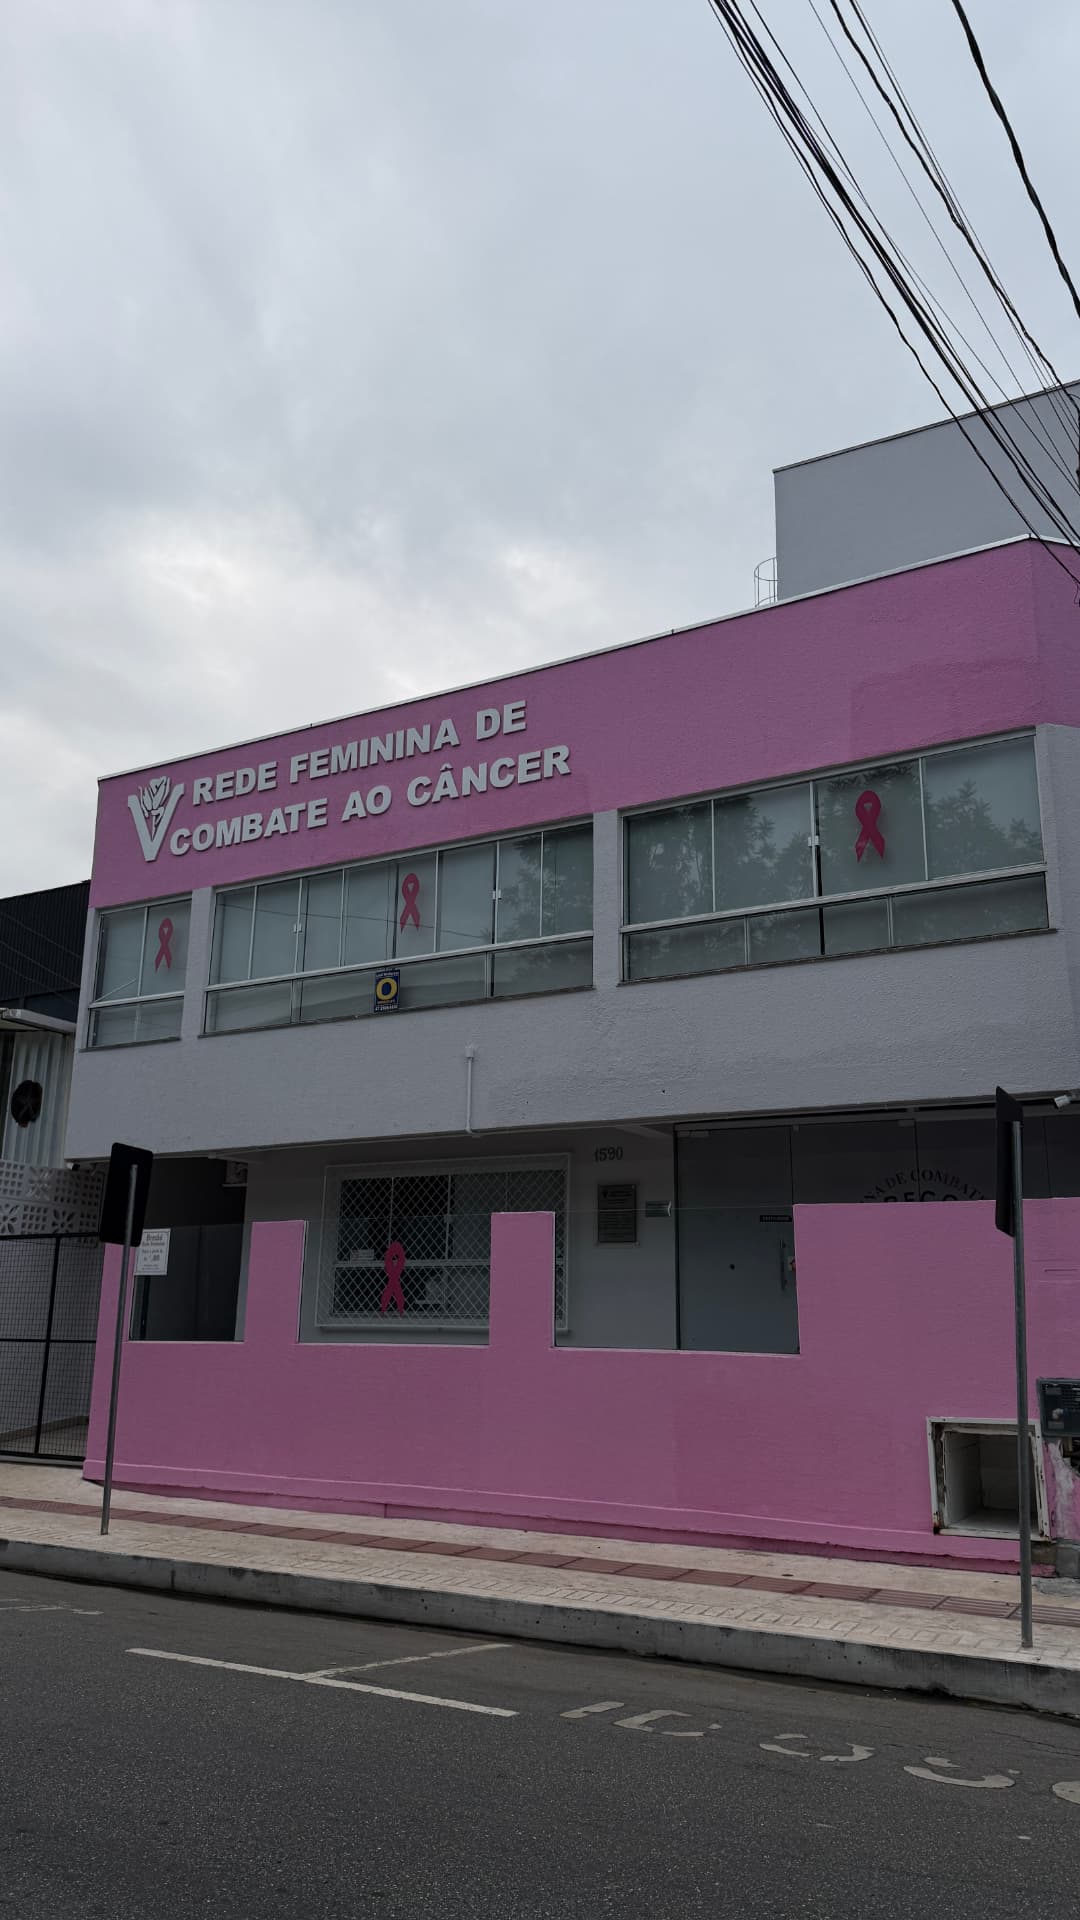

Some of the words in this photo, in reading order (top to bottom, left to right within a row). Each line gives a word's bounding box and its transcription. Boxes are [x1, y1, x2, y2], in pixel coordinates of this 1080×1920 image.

[192, 761, 278, 807] REDE
[289, 718, 460, 784] FEMININA
[475, 699, 527, 741] DE
[169, 797, 329, 857] COMBATE
[340, 784, 393, 823] AO
[406, 744, 571, 807] CÂNCER
[594, 1146, 624, 1163] 1590
[885, 1171, 908, 1190] DE
